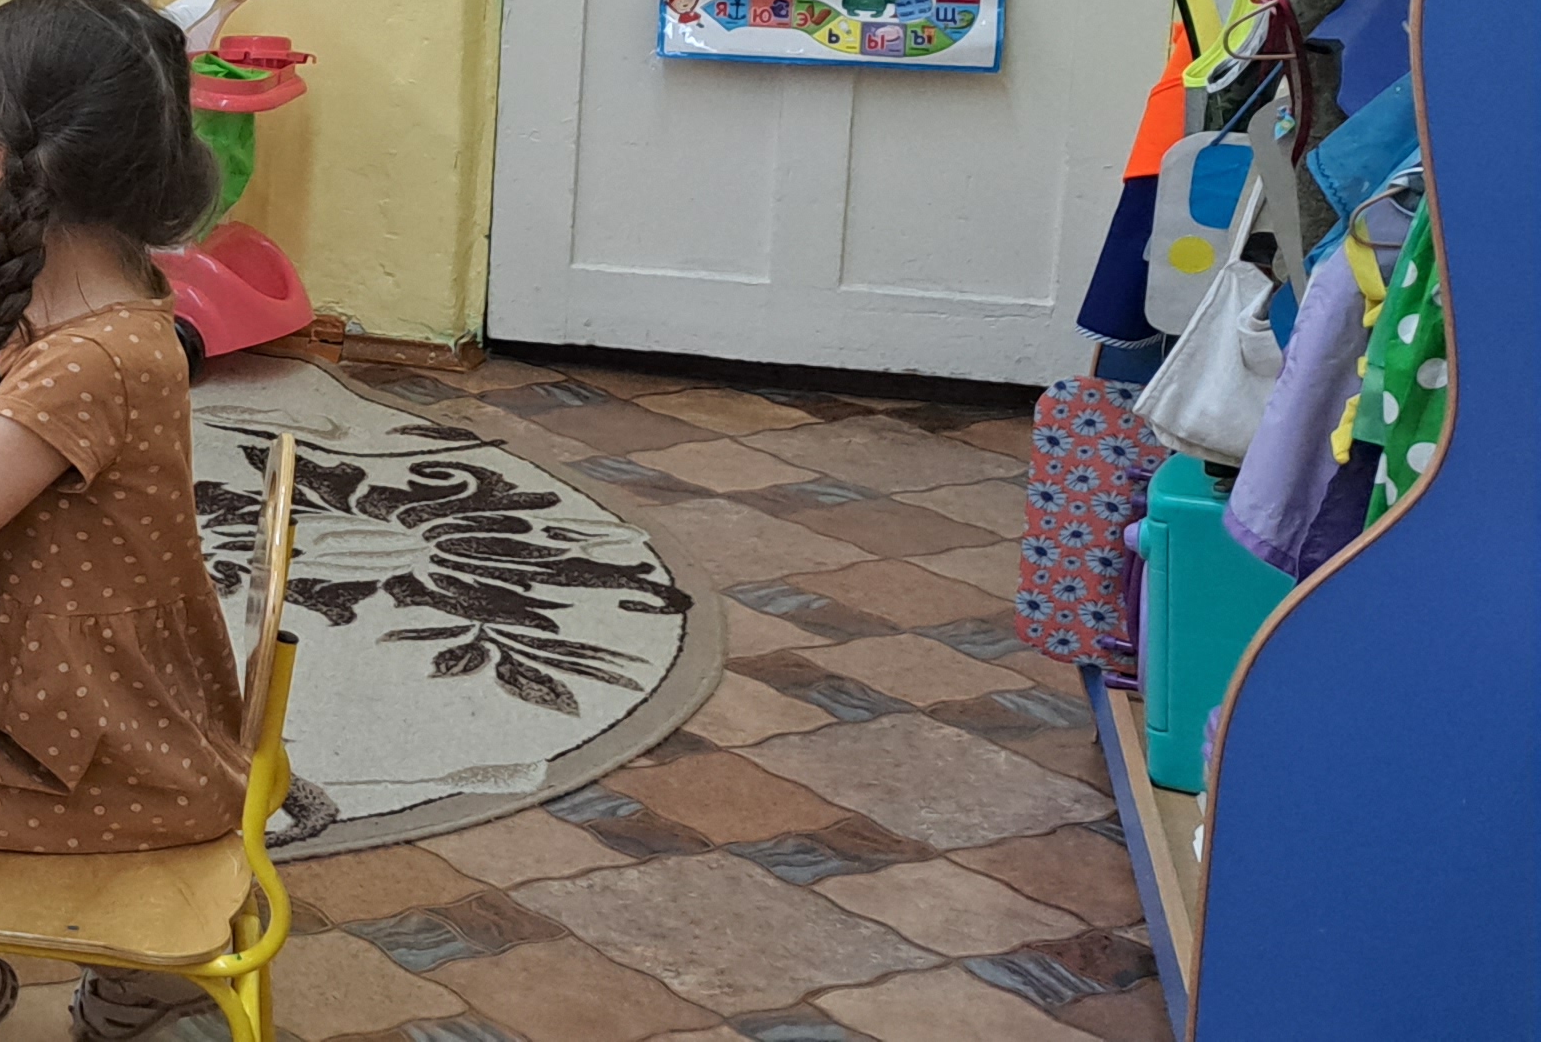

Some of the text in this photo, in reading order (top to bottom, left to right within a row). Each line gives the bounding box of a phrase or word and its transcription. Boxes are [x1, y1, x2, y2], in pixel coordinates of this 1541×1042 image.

[715, 2, 728, 17] Я
[753, 9, 772, 23] Ю
[936, 7, 957, 25] Щ
[796, 12, 809, 27] Э
[828, 28, 840, 44] Ь
[867, 34, 885, 50] Ы
